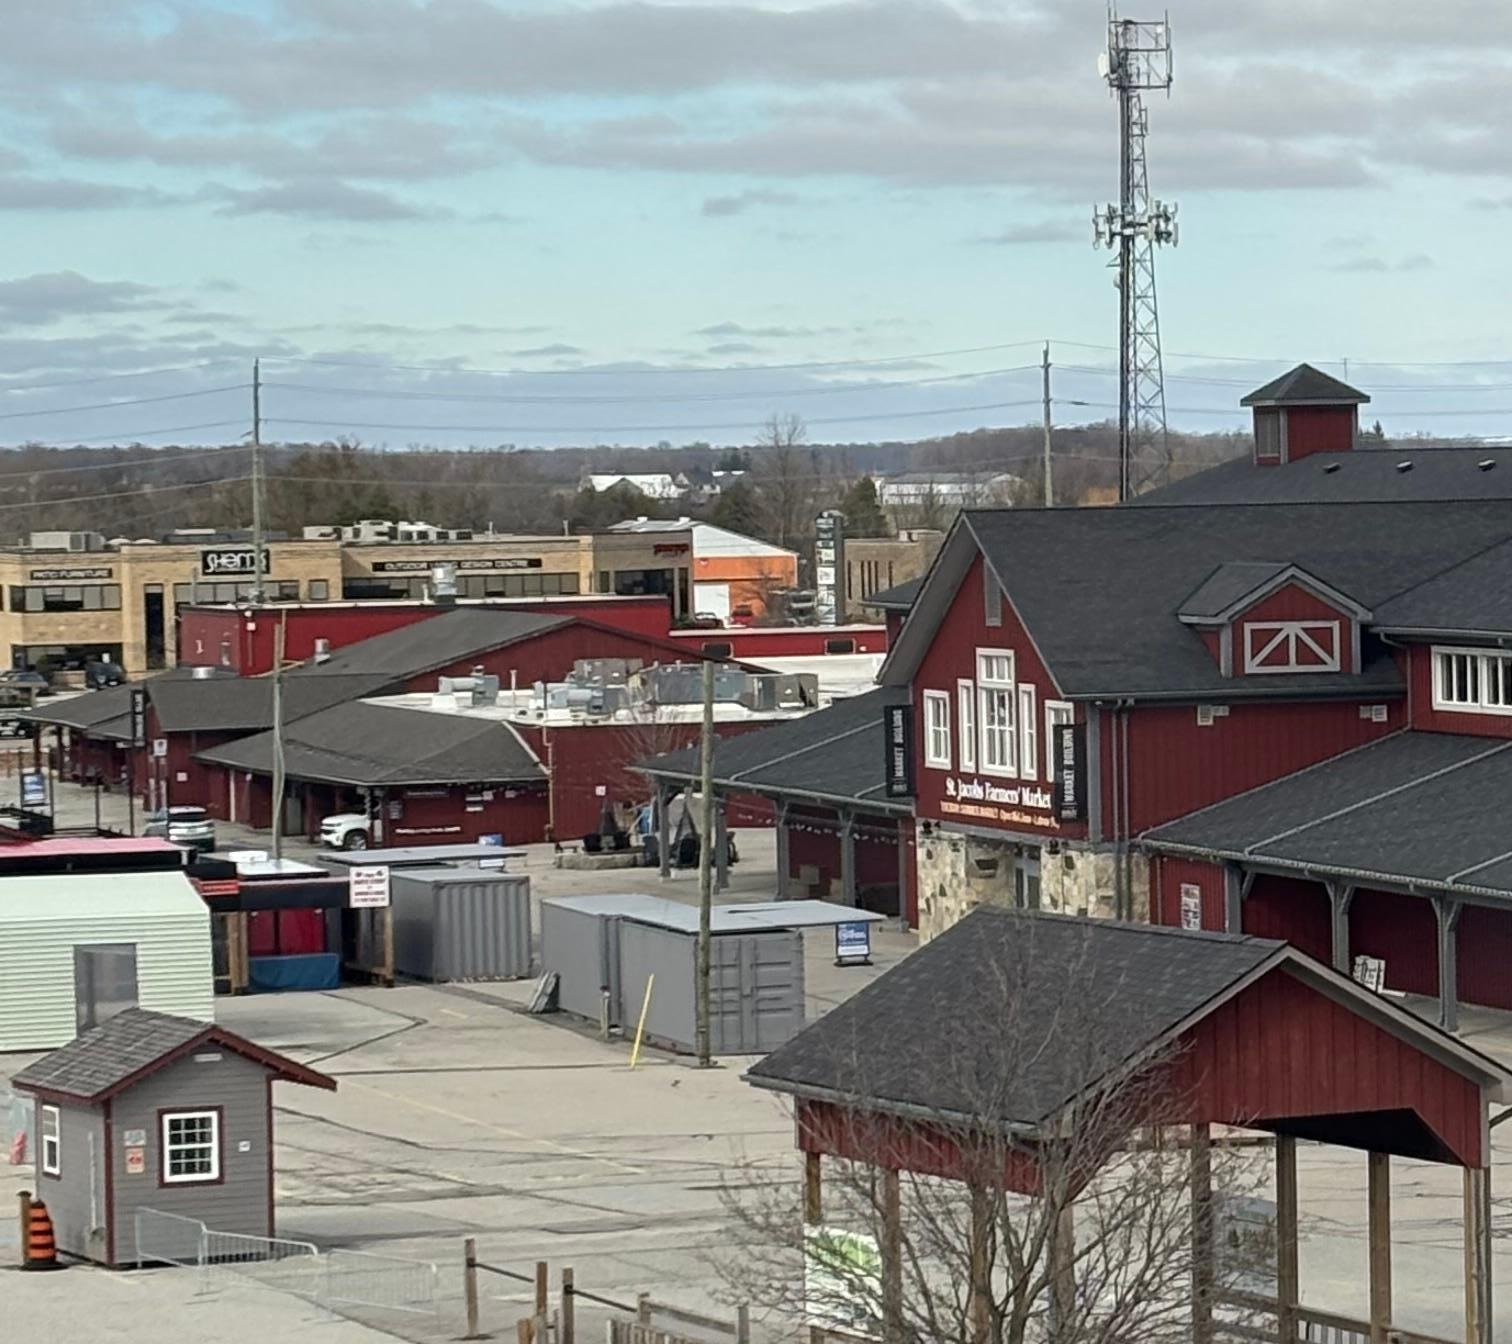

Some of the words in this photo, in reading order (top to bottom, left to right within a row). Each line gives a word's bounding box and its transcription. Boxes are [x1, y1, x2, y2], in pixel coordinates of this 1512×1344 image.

[893, 747, 905, 777] MARKET
[1062, 728, 1074, 765] BUILDING
[957, 778, 984, 801] Jacobs
[1021, 786, 1052, 809] Market
[1063, 769, 1075, 802] MARKET
